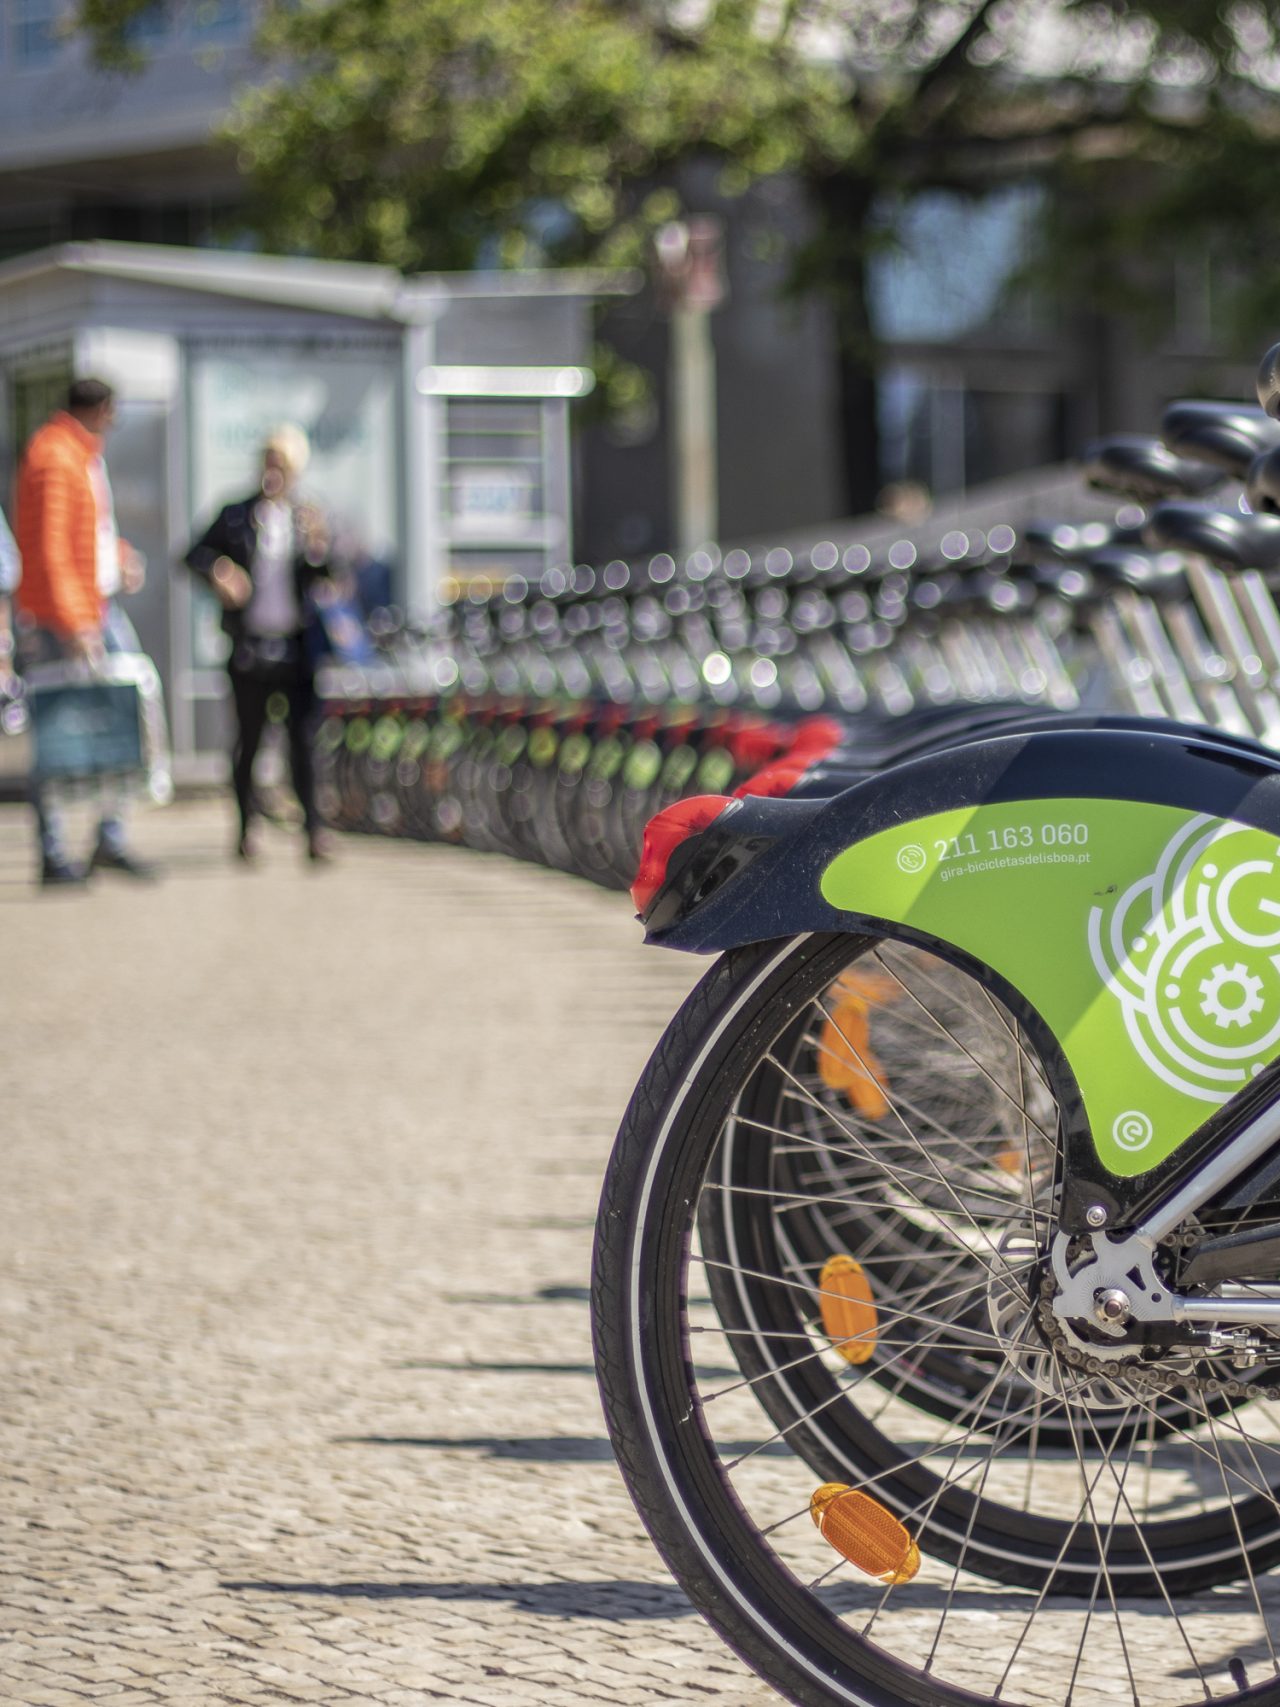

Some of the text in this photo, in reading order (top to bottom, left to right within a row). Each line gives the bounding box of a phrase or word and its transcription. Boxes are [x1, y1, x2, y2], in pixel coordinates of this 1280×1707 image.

[934, 824, 1089, 861] 211 163 060
[940, 852, 1091, 881] gira-bicicletasdelisboa.pt
